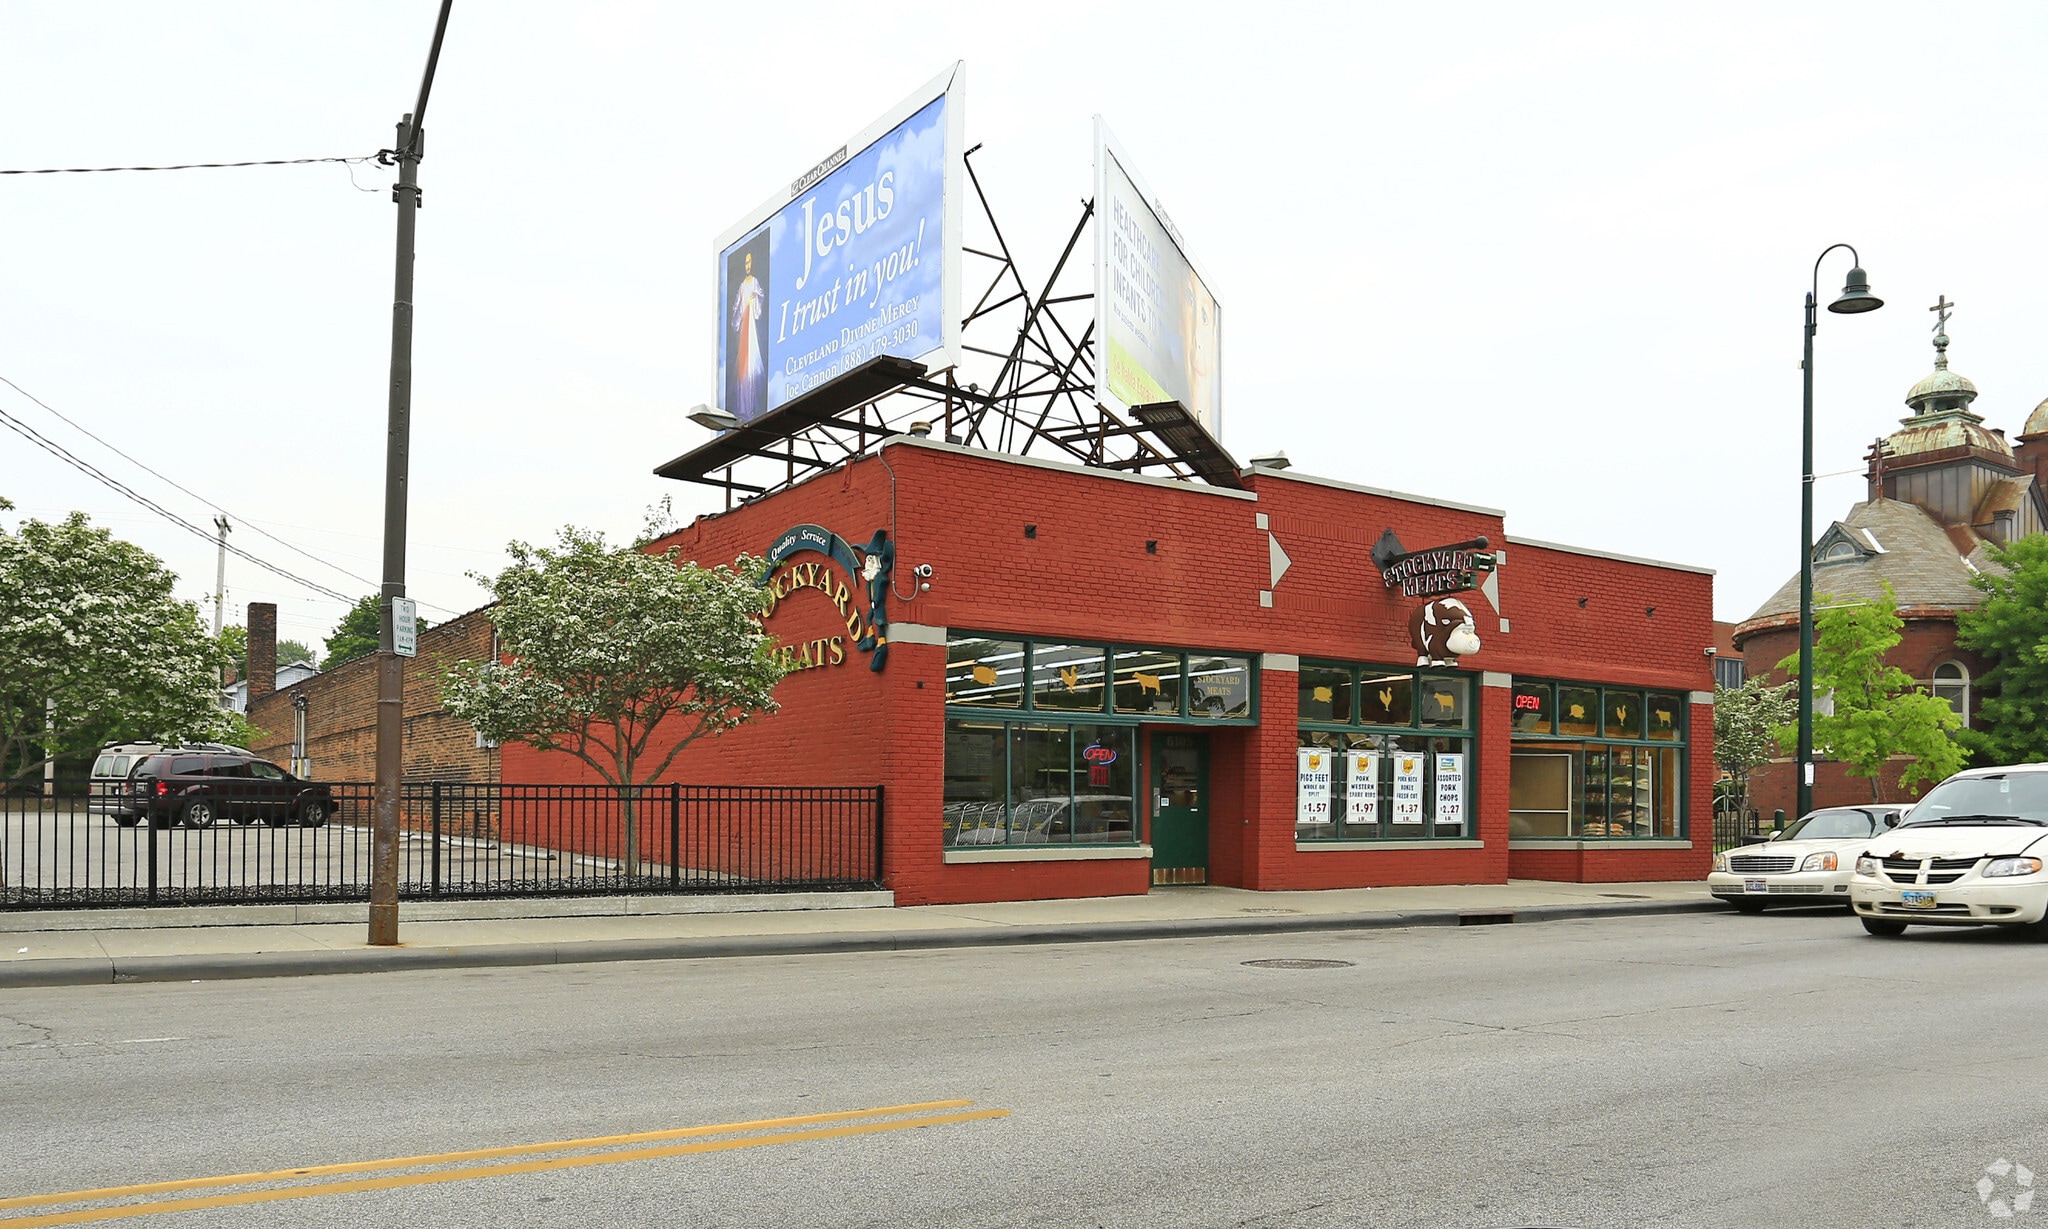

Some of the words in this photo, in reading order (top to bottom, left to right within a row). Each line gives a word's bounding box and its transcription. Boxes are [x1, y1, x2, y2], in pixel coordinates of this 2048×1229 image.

[799, 169, 818, 190] CLEAR
[817, 149, 846, 177] CHANNEL
[796, 171, 895, 290] Jesus
[1113, 195, 1161, 278] HEALTHCARE
[1113, 230, 1128, 272] FOR
[777, 300, 791, 344] I
[792, 278, 841, 335] trust
[845, 263, 867, 306] in
[870, 217, 925, 309] you!
[1113, 265, 1147, 323] INFANTS
[1147, 304, 1157, 336] TO
[785, 339, 838, 375] CLEVELAND
[841, 318, 877, 348] DIVINE
[879, 295, 920, 328] MERCY
[785, 384, 799, 402] Joe
[802, 365, 837, 392] Cannon
[839, 345, 866, 375] (888)
[869, 319, 918, 358] 479-3030
[771, 535, 797, 562] Quality
[801, 530, 826, 546] Service
[1383, 550, 1475, 588] STOCKYARD
[1402, 570, 1459, 597] MEATS
[771, 636, 844, 669] EATS
[1197, 675, 1240, 685] STOCKYARD
[1207, 686, 1231, 696] MEATS
[1516, 695, 1540, 709] OPEN
[1085, 749, 1113, 760] OPEN
[1300, 773, 1313, 782] PIGS
[1315, 773, 1328, 782] FEET
[1437, 774, 1461, 782] ASSORTED
[1304, 802, 1327, 812] $1.57
[1352, 803, 1374, 813] $1.97
[1397, 804, 1418, 813] $1.37
[1440, 804, 1459, 813] $2.27
